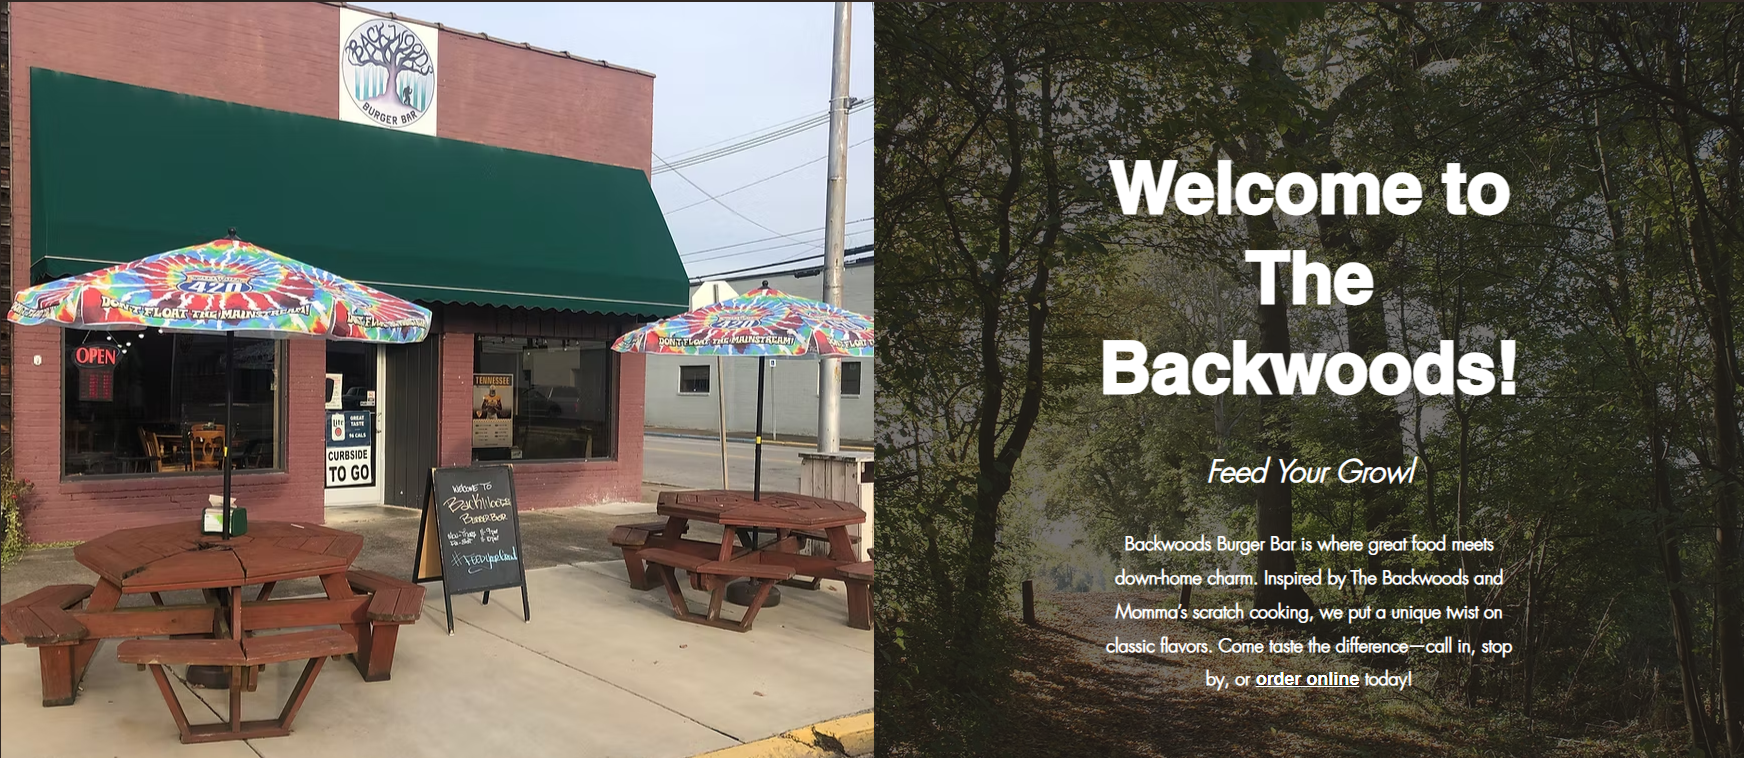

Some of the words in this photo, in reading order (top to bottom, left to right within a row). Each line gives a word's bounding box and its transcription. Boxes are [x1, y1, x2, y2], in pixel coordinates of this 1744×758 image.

[362, 101, 398, 125] BURGER
[400, 110, 418, 124] BAR
[188, 281, 243, 293] 420
[144, 307, 188, 320] FLOAT
[192, 309, 217, 319] THE
[220, 304, 311, 320] MAINSTREAM!
[685, 338, 711, 346] FLOAT
[731, 334, 794, 346] MAINSTREAM!
[76, 347, 116, 365] OPEN
[475, 376, 510, 385] TENNESSEE
[328, 449, 368, 461] CURBSIDE
[329, 466, 346, 482] TO
[351, 464, 369, 481] GO
[480, 481, 492, 490] TO
